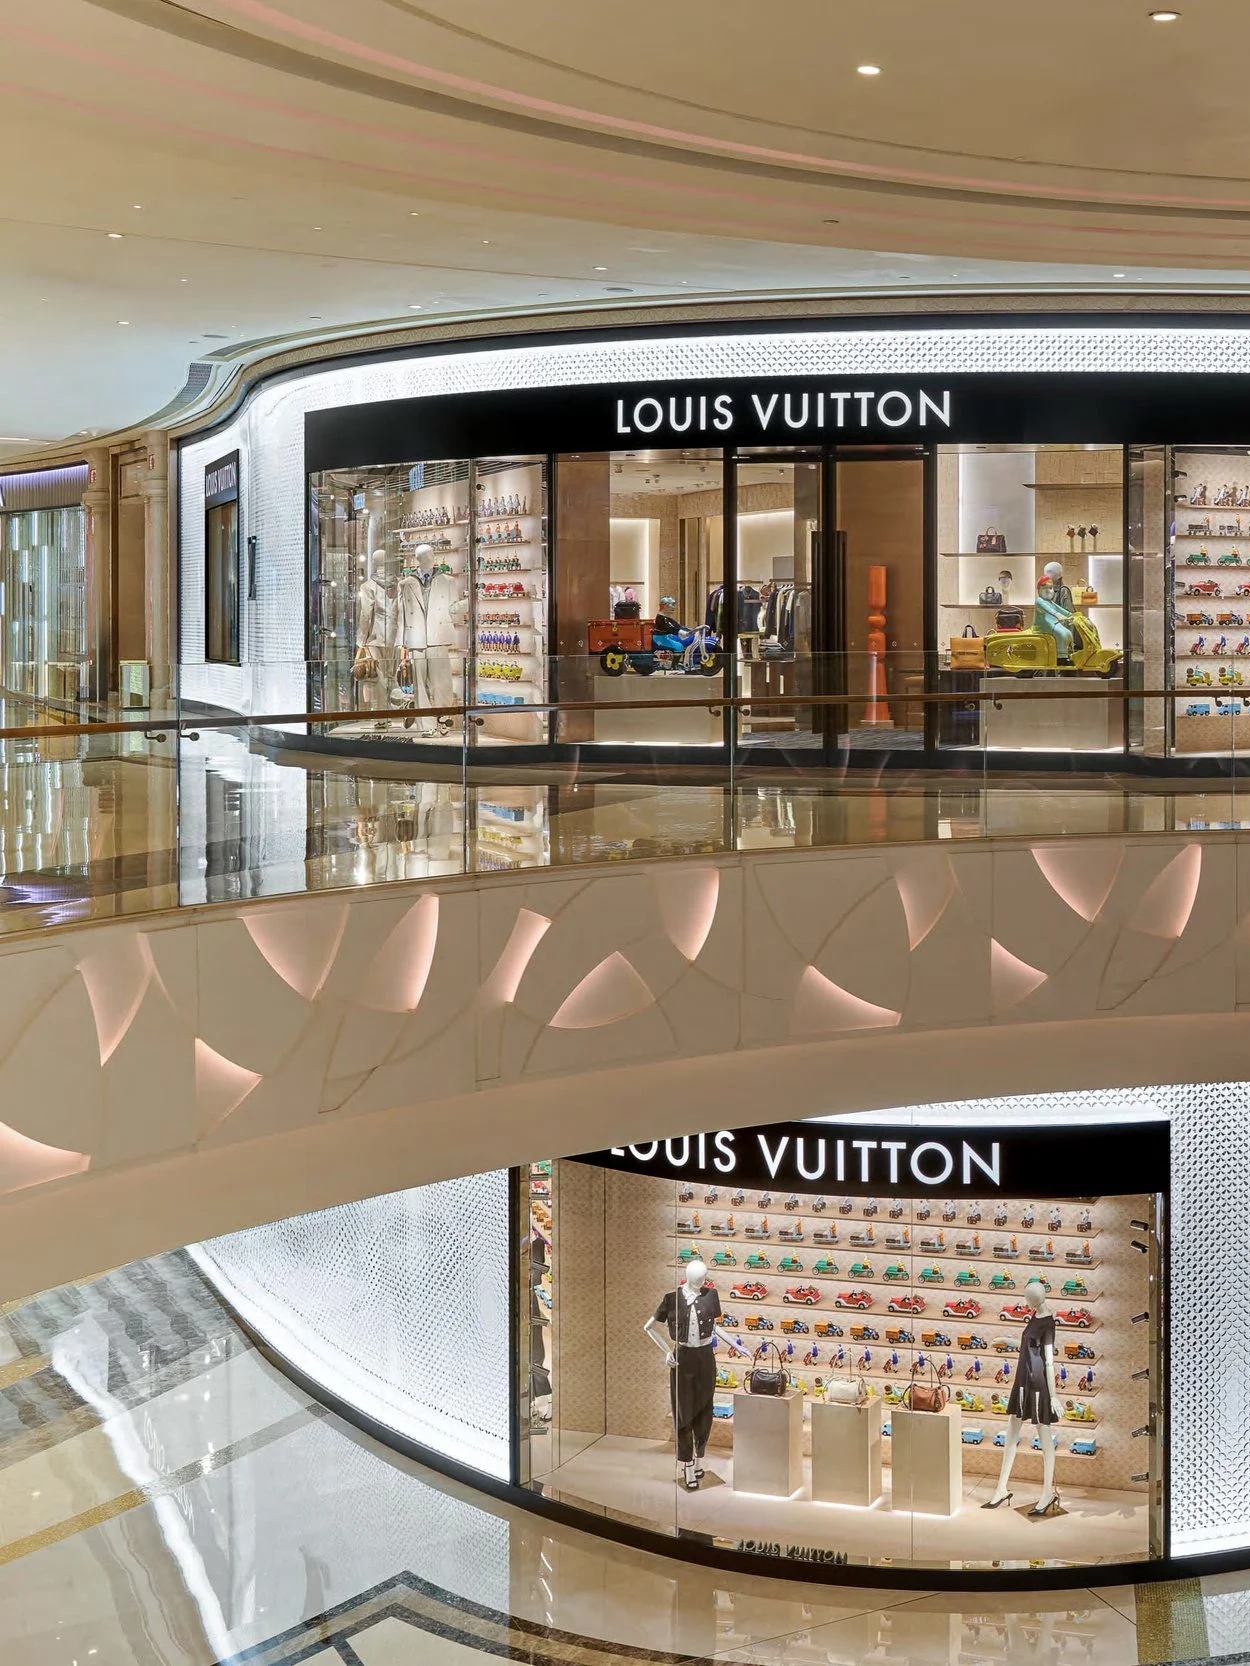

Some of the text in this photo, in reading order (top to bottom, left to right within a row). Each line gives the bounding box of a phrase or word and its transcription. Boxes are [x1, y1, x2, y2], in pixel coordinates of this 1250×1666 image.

[616, 389, 951, 434] LOUIS VUITTON
[205, 461, 237, 498] LOUIS VUITTON
[611, 1131, 1000, 1187] OUIS VUITTON
